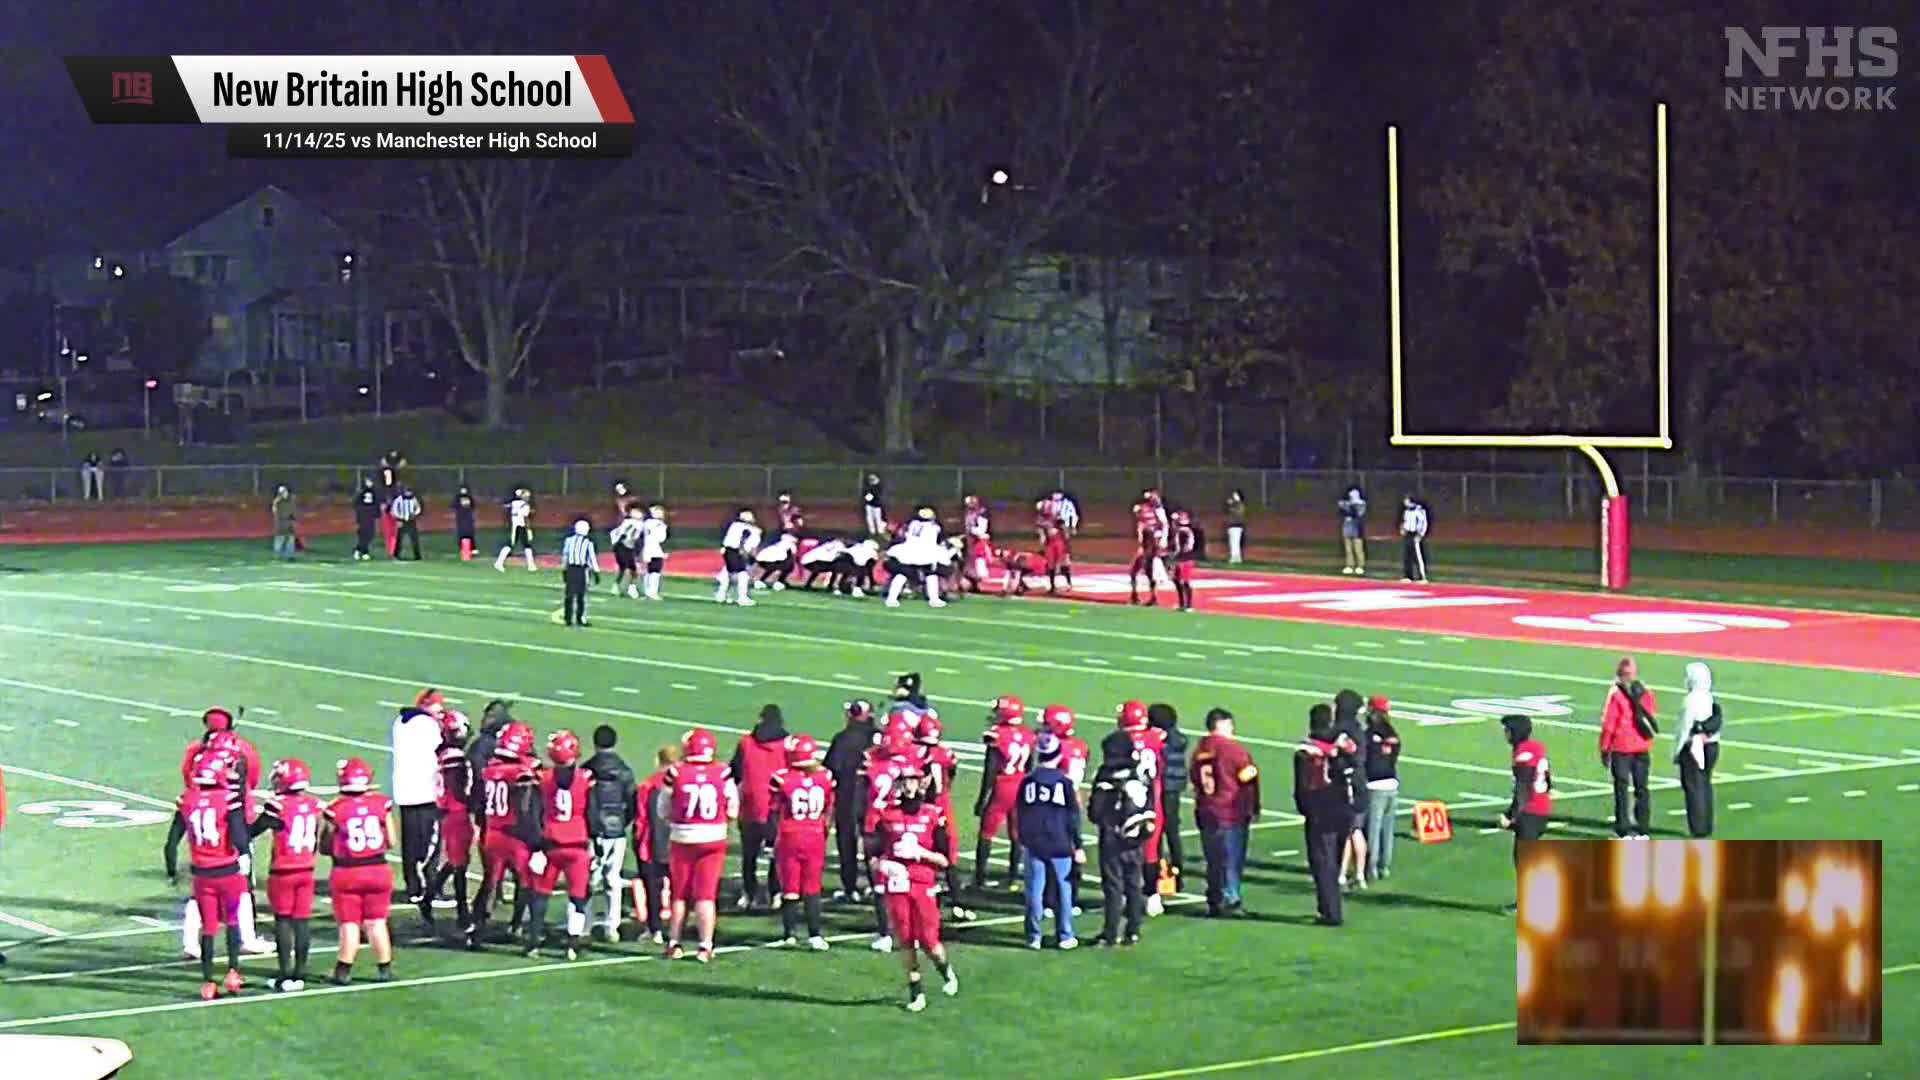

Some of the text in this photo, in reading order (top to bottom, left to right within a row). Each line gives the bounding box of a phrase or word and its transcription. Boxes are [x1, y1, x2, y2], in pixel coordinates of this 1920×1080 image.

[556, 788, 573, 822] 9
[682, 783, 718, 820] 78
[1025, 782, 1066, 806] USA
[189, 807, 219, 847] 14
[1421, 806, 1446, 833] 20
